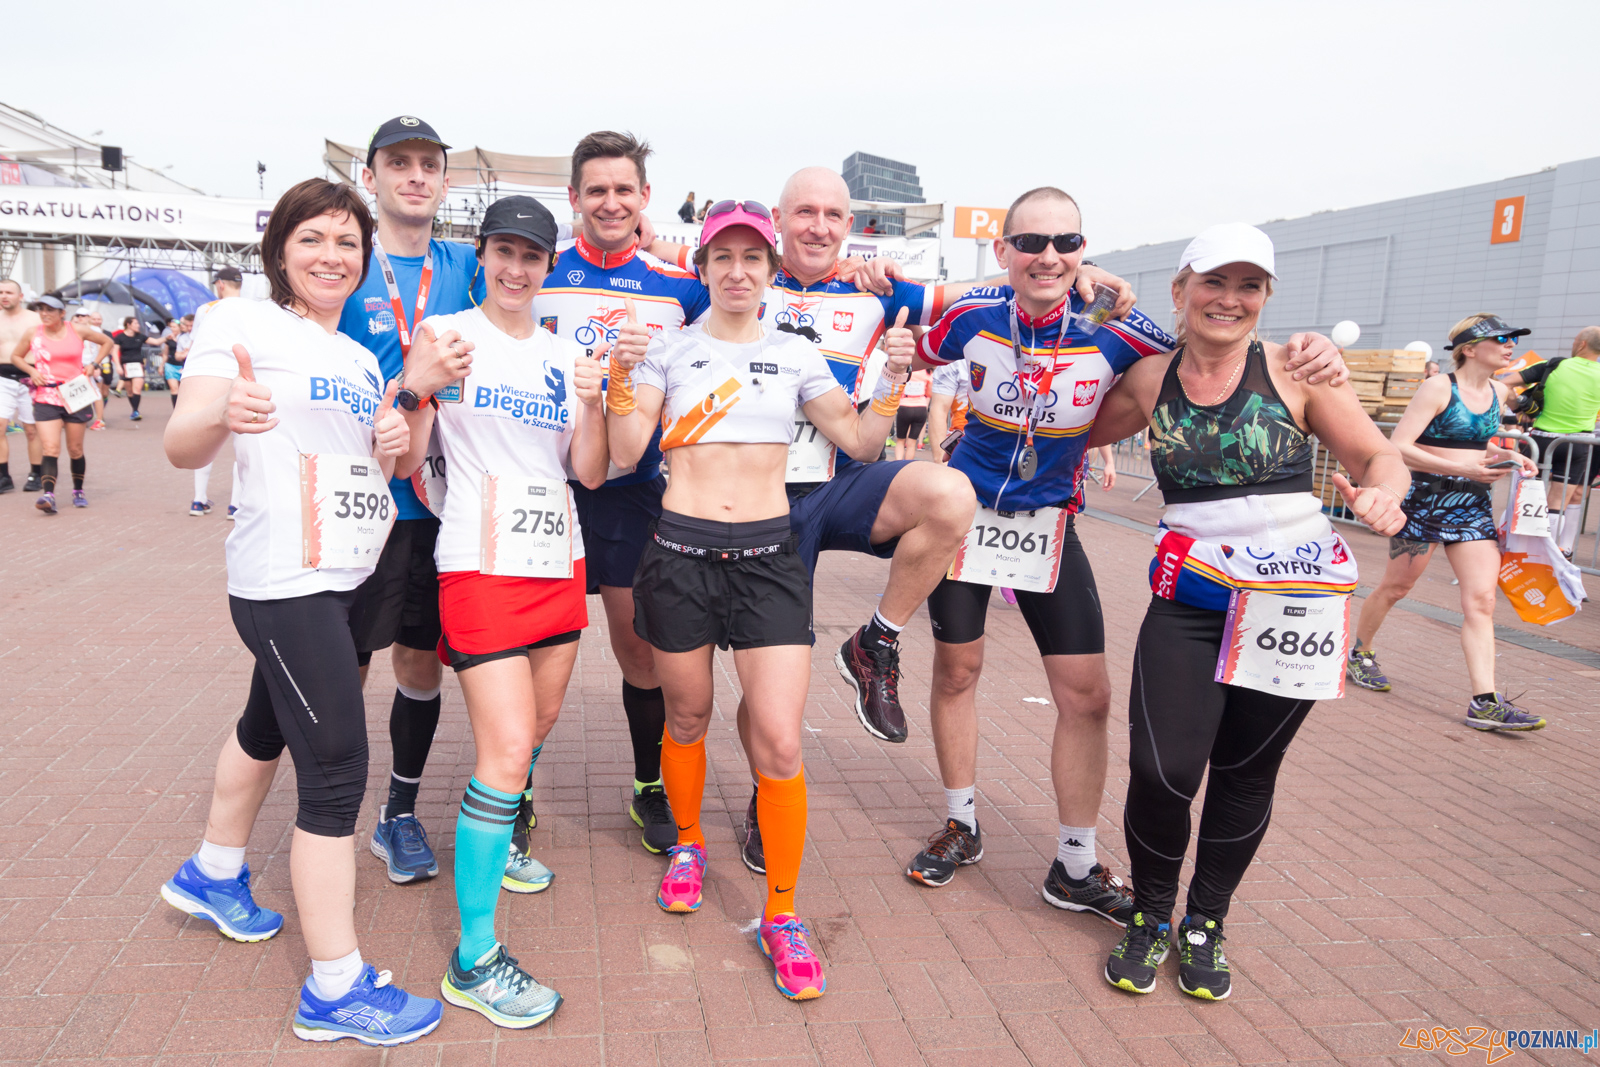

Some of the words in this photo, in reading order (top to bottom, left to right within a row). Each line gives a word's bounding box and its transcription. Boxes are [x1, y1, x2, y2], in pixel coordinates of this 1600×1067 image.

[0, 200, 182, 224] GRATULATIONS!
[1501, 205, 1515, 235] 3
[609, 277, 642, 290] WOJTEK
[69, 384, 88, 398] 4713
[500, 383, 552, 402] Wieczorne
[474, 385, 568, 424] Bieganie
[334, 491, 389, 521] 3598
[357, 526, 375, 535] Marta
[511, 508, 565, 537] 2756
[533, 540, 551, 548] Lidka
[975, 525, 1049, 556] 12061
[996, 553, 1021, 563] Marcin
[1256, 560, 1323, 576] GRYFUS
[1256, 627, 1335, 657] 6866
[1275, 659, 1315, 671] Krystyna
